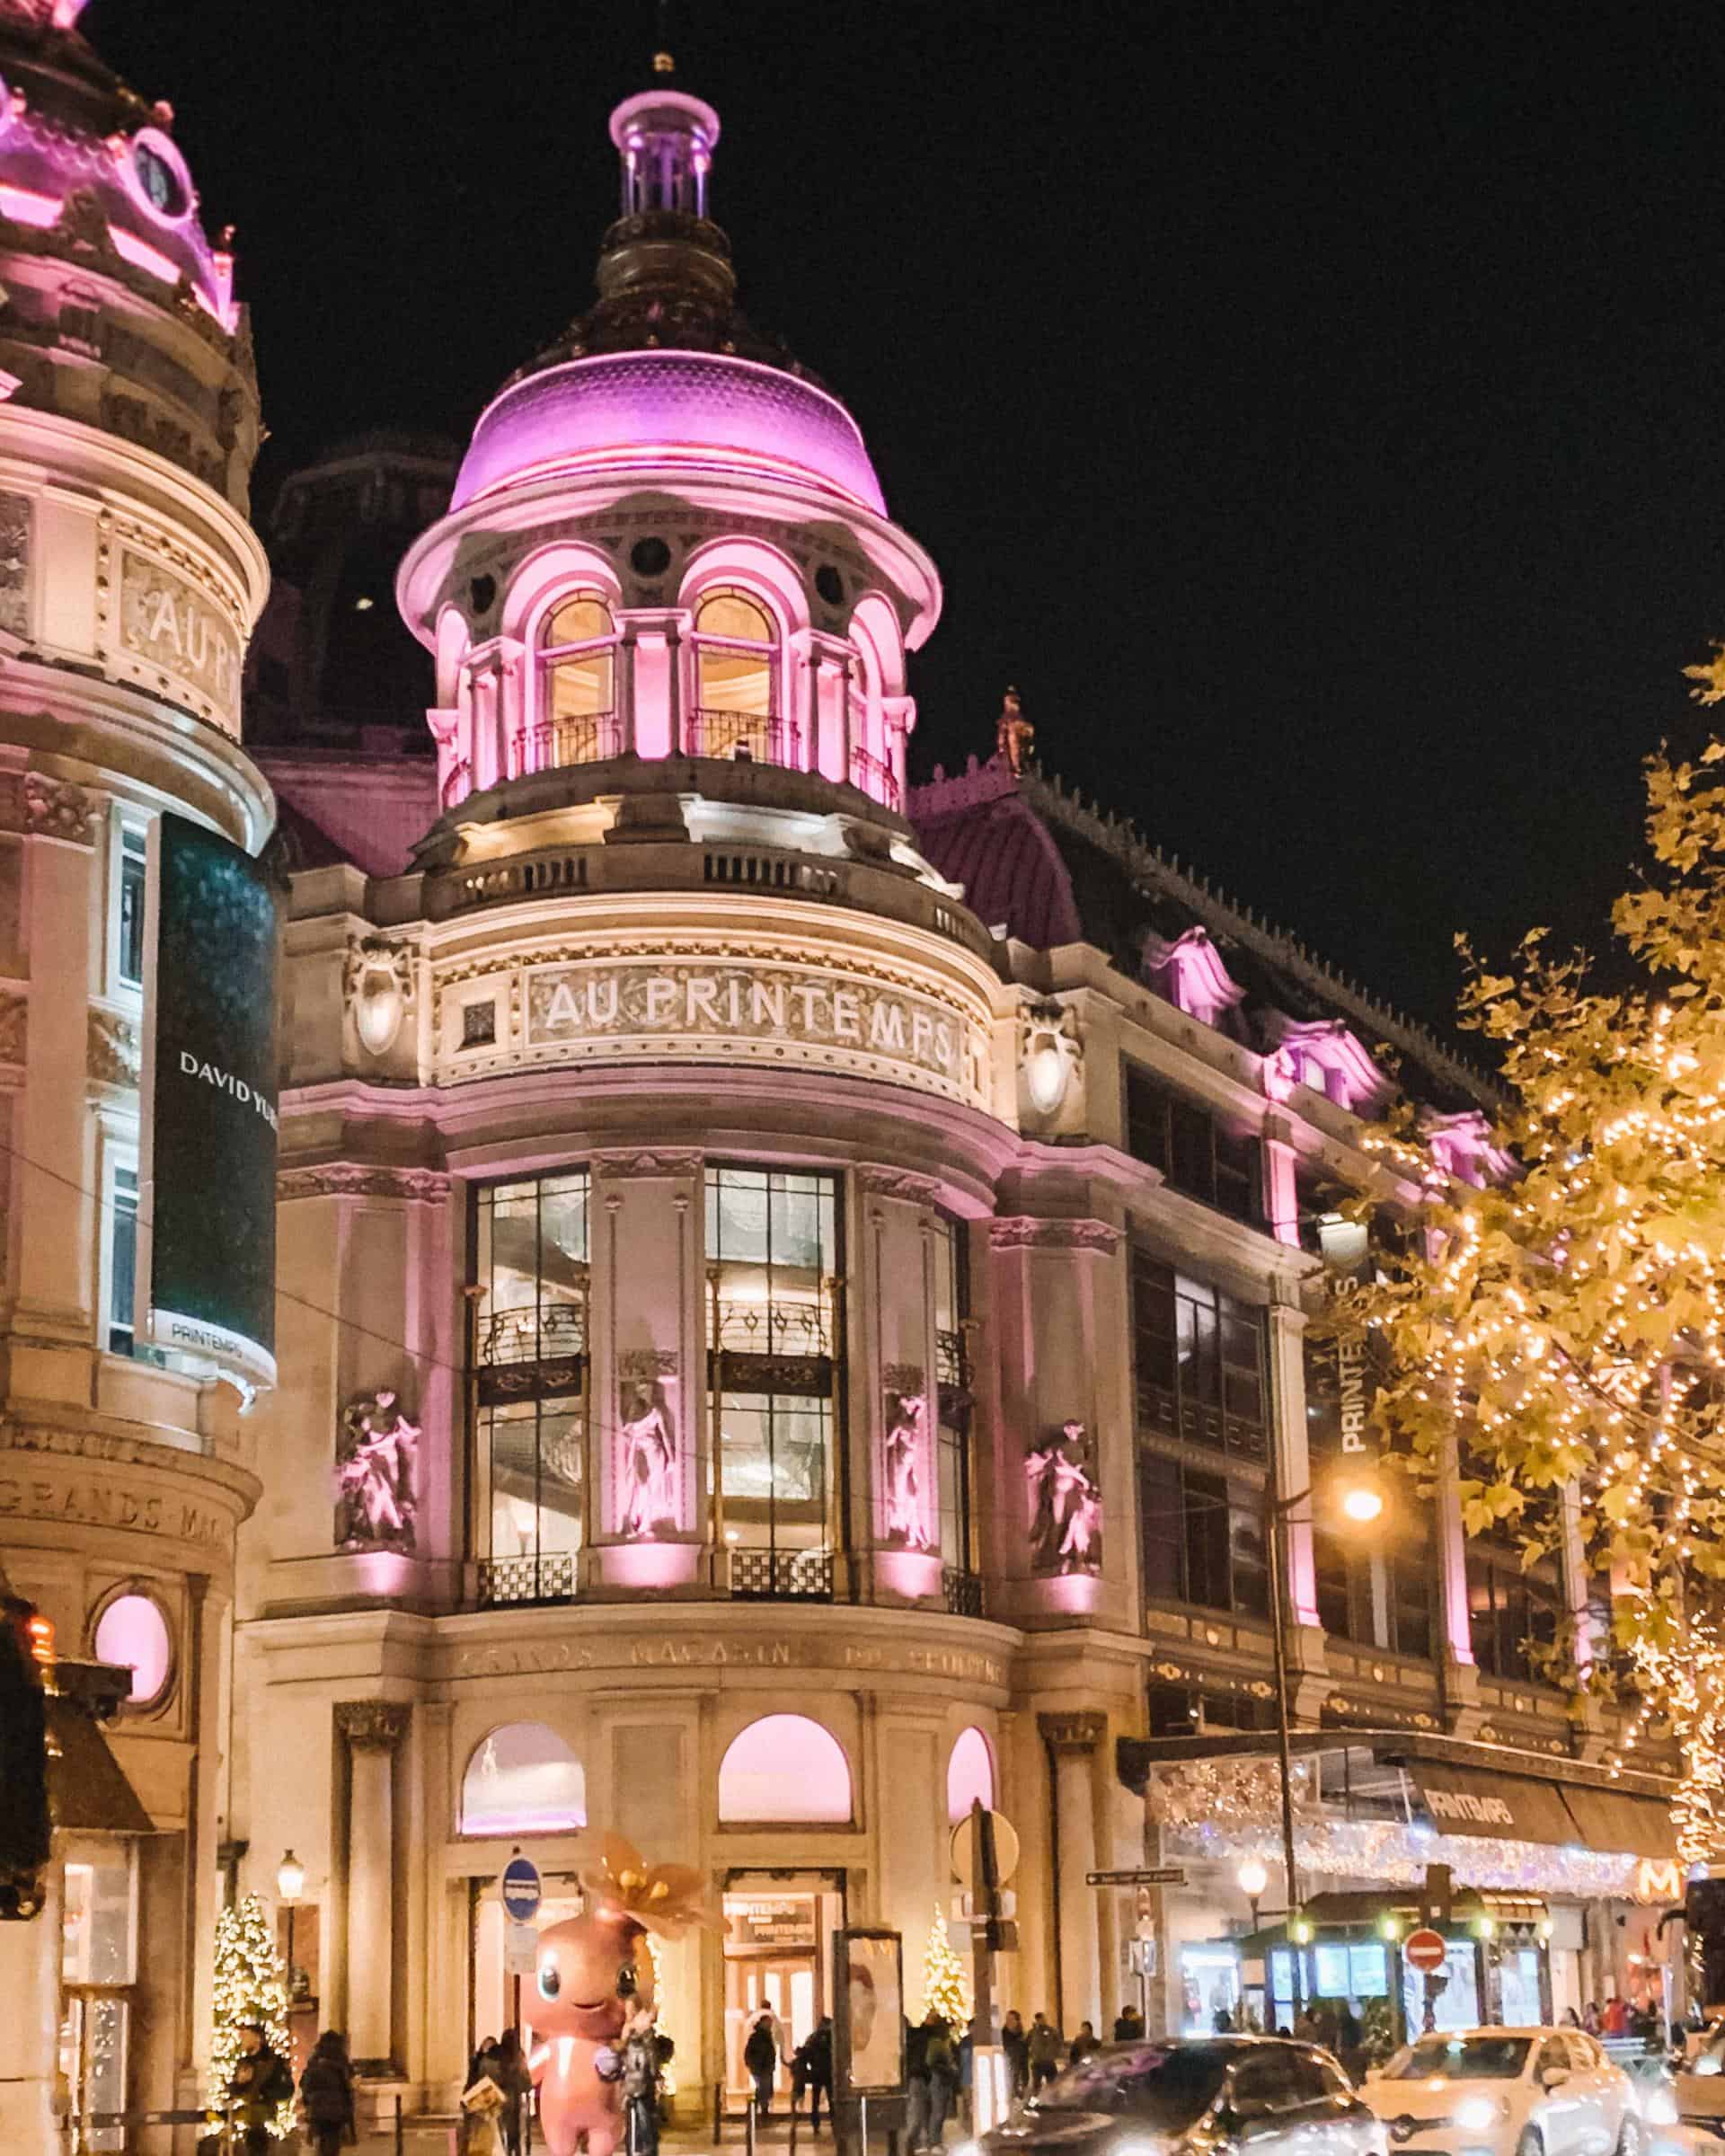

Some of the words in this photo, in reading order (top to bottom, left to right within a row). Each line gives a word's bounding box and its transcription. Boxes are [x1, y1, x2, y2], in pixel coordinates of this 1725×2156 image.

[149, 590, 208, 669] AU
[544, 977, 619, 1029] AU
[645, 976, 951, 1067] PRINTEMPS
[180, 1050, 251, 1103] DAVID
[1335, 1276, 1367, 1454] PRINTES
[1423, 1788, 1516, 1825] PRINTEMPS
[1639, 1860, 1681, 1899] M
